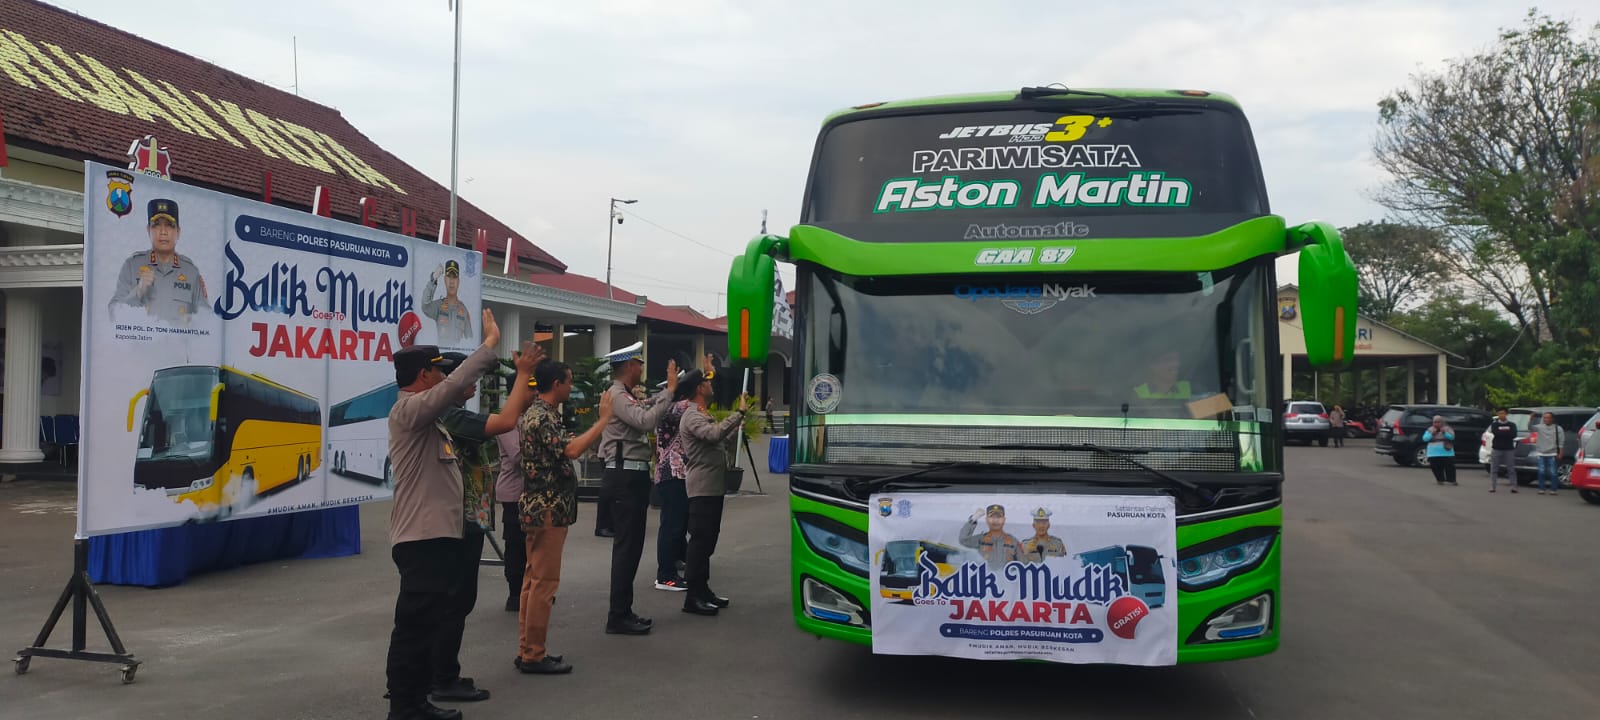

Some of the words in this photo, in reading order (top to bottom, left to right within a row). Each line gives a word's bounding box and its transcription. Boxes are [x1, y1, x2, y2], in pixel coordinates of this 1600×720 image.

[939, 124, 1053, 139] JETBUS
[912, 145, 1141, 173] PARIWISATA
[873, 176, 1022, 214] Aston
[1032, 171, 1192, 208] Martin
[260, 226, 296, 242] BARENG
[297, 234, 329, 249] POLRES
[330, 239, 371, 256] PASURUAN
[371, 246, 391, 259] KOTA
[964, 222, 1090, 240] Automatic
[1038, 246, 1076, 264] 87
[214, 241, 315, 320] Balik
[316, 266, 414, 333] Mudik
[312, 309, 333, 321] Goes
[334, 311, 345, 321] To
[249, 322, 394, 362] JAKARTA
[320, 499, 340, 508] MUDIK
[914, 552, 1004, 603] Balik
[1004, 561, 1125, 607] Mudik
[915, 597, 936, 607] Goes
[937, 598, 946, 607] To
[949, 599, 1094, 625] JAKARTA
[1112, 606, 1144, 631] GRATIS!
[959, 627, 989, 636] BARENG
[989, 629, 1020, 638] POLRES
[1020, 630, 1062, 640] PASURUAN
[1063, 632, 1084, 641] KOTA
